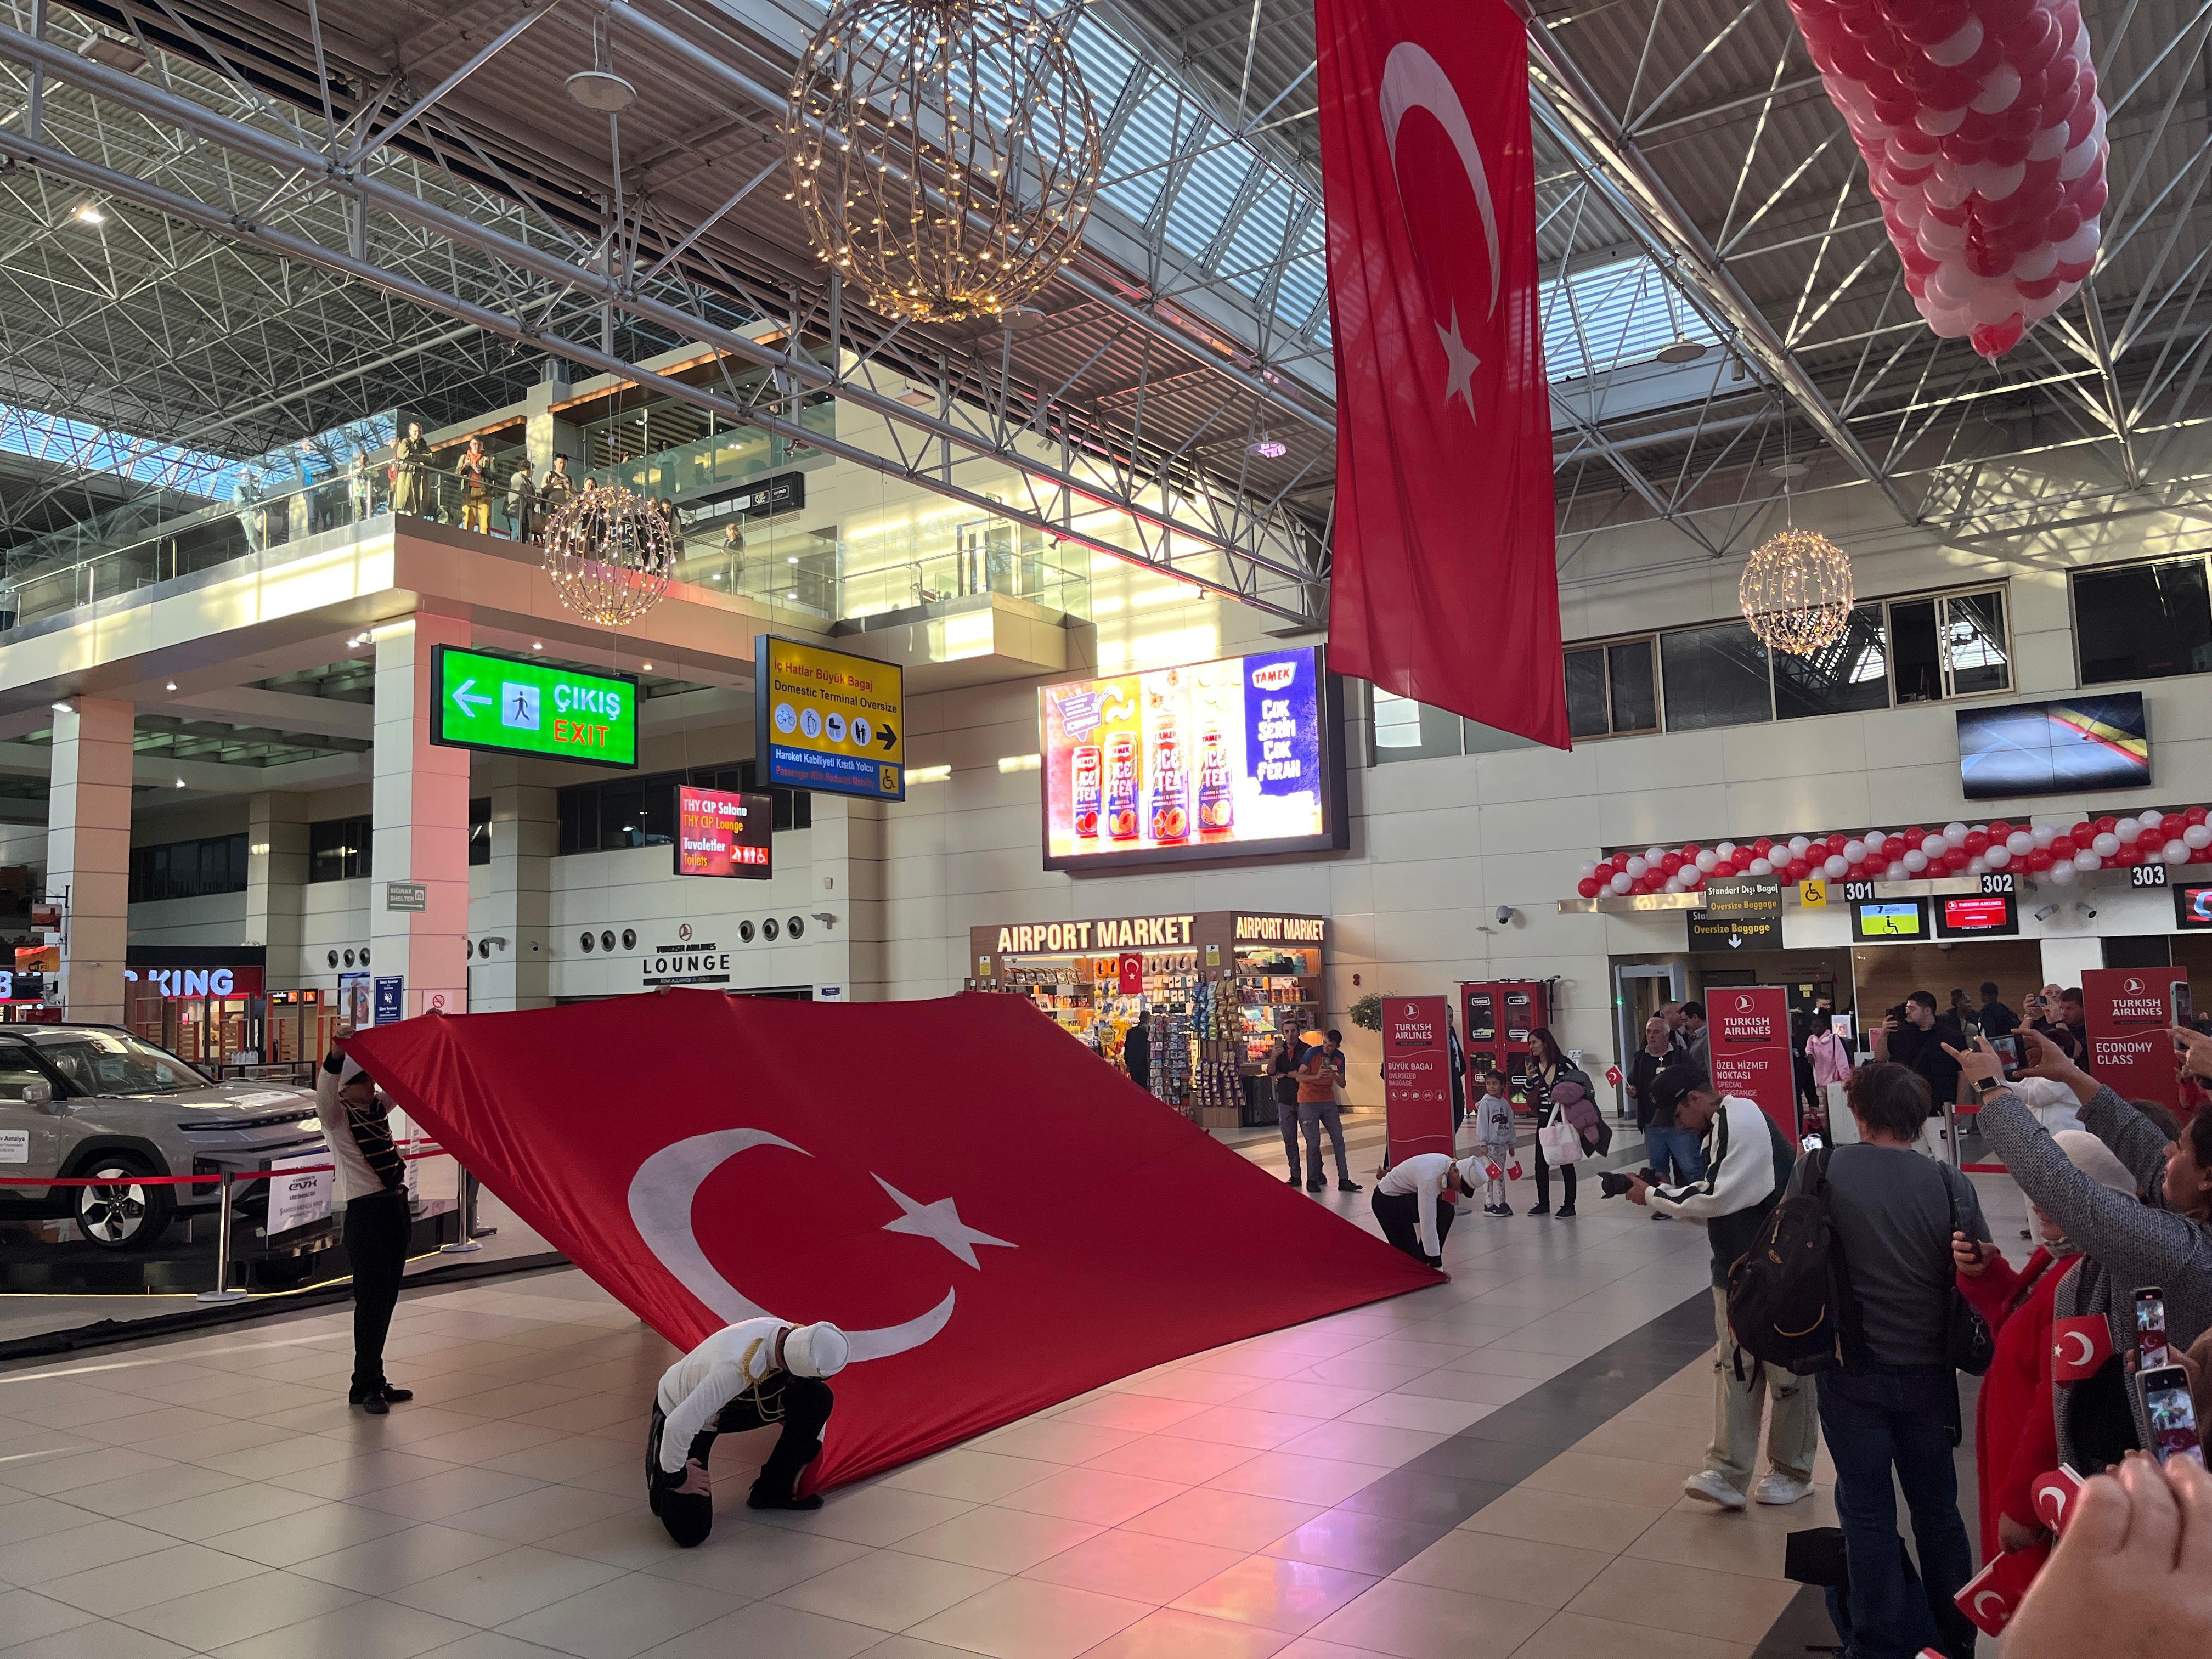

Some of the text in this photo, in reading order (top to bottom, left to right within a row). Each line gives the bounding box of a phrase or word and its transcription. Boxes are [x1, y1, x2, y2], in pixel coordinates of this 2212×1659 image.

[775, 657, 873, 692] İç Hatlar Büyük Bagaj
[1255, 668, 1290, 684] TAMEK
[554, 684, 620, 720] ÇIKIŞ
[774, 680, 897, 713] Domestic Terminal Oversize
[554, 719, 610, 748] EXIT
[776, 749, 803, 762] Hareket
[804, 753, 835, 768] Kabiliyeti
[856, 761, 873, 772] Yolcu
[776, 765, 808, 780] Passenger
[683, 799, 748, 817] THY CIP Salonu
[684, 814, 743, 834] THY CIP Lounge
[683, 837, 726, 852] Tuvaletler
[684, 853, 708, 866] Toilets
[2132, 866, 2165, 885] 303
[390, 887, 413, 895] SIĞINAK
[1708, 884, 1779, 895] Standart Dışı Bagaj
[1846, 882, 1872, 900] 301
[1983, 874, 2013, 893] 302
[1744, 901, 1777, 910] Baggage
[997, 916, 1195, 952] AIRPORT MARKET
[1236, 916, 1325, 941] AIRPORT MARKET
[1694, 923, 1770, 935] Oversize Baggage
[643, 954, 730, 974] LOUNGE
[149, 968, 233, 997] KING
[2112, 999, 2161, 1008] TURKISH
[2112, 1007, 2162, 1017] AIRLINES
[1724, 1017, 1770, 1026] TURKISH
[1724, 1026, 1771, 1035] AIRLINES
[2096, 1042, 2153, 1053] ECONOMY
[1388, 1062, 1409, 1070] BÜYÜK
[1716, 1059, 1769, 1070] ÖZEL HİZMET
[2097, 1054, 2134, 1064] CLASS
[1717, 1071, 1751, 1080] NOKTASI
